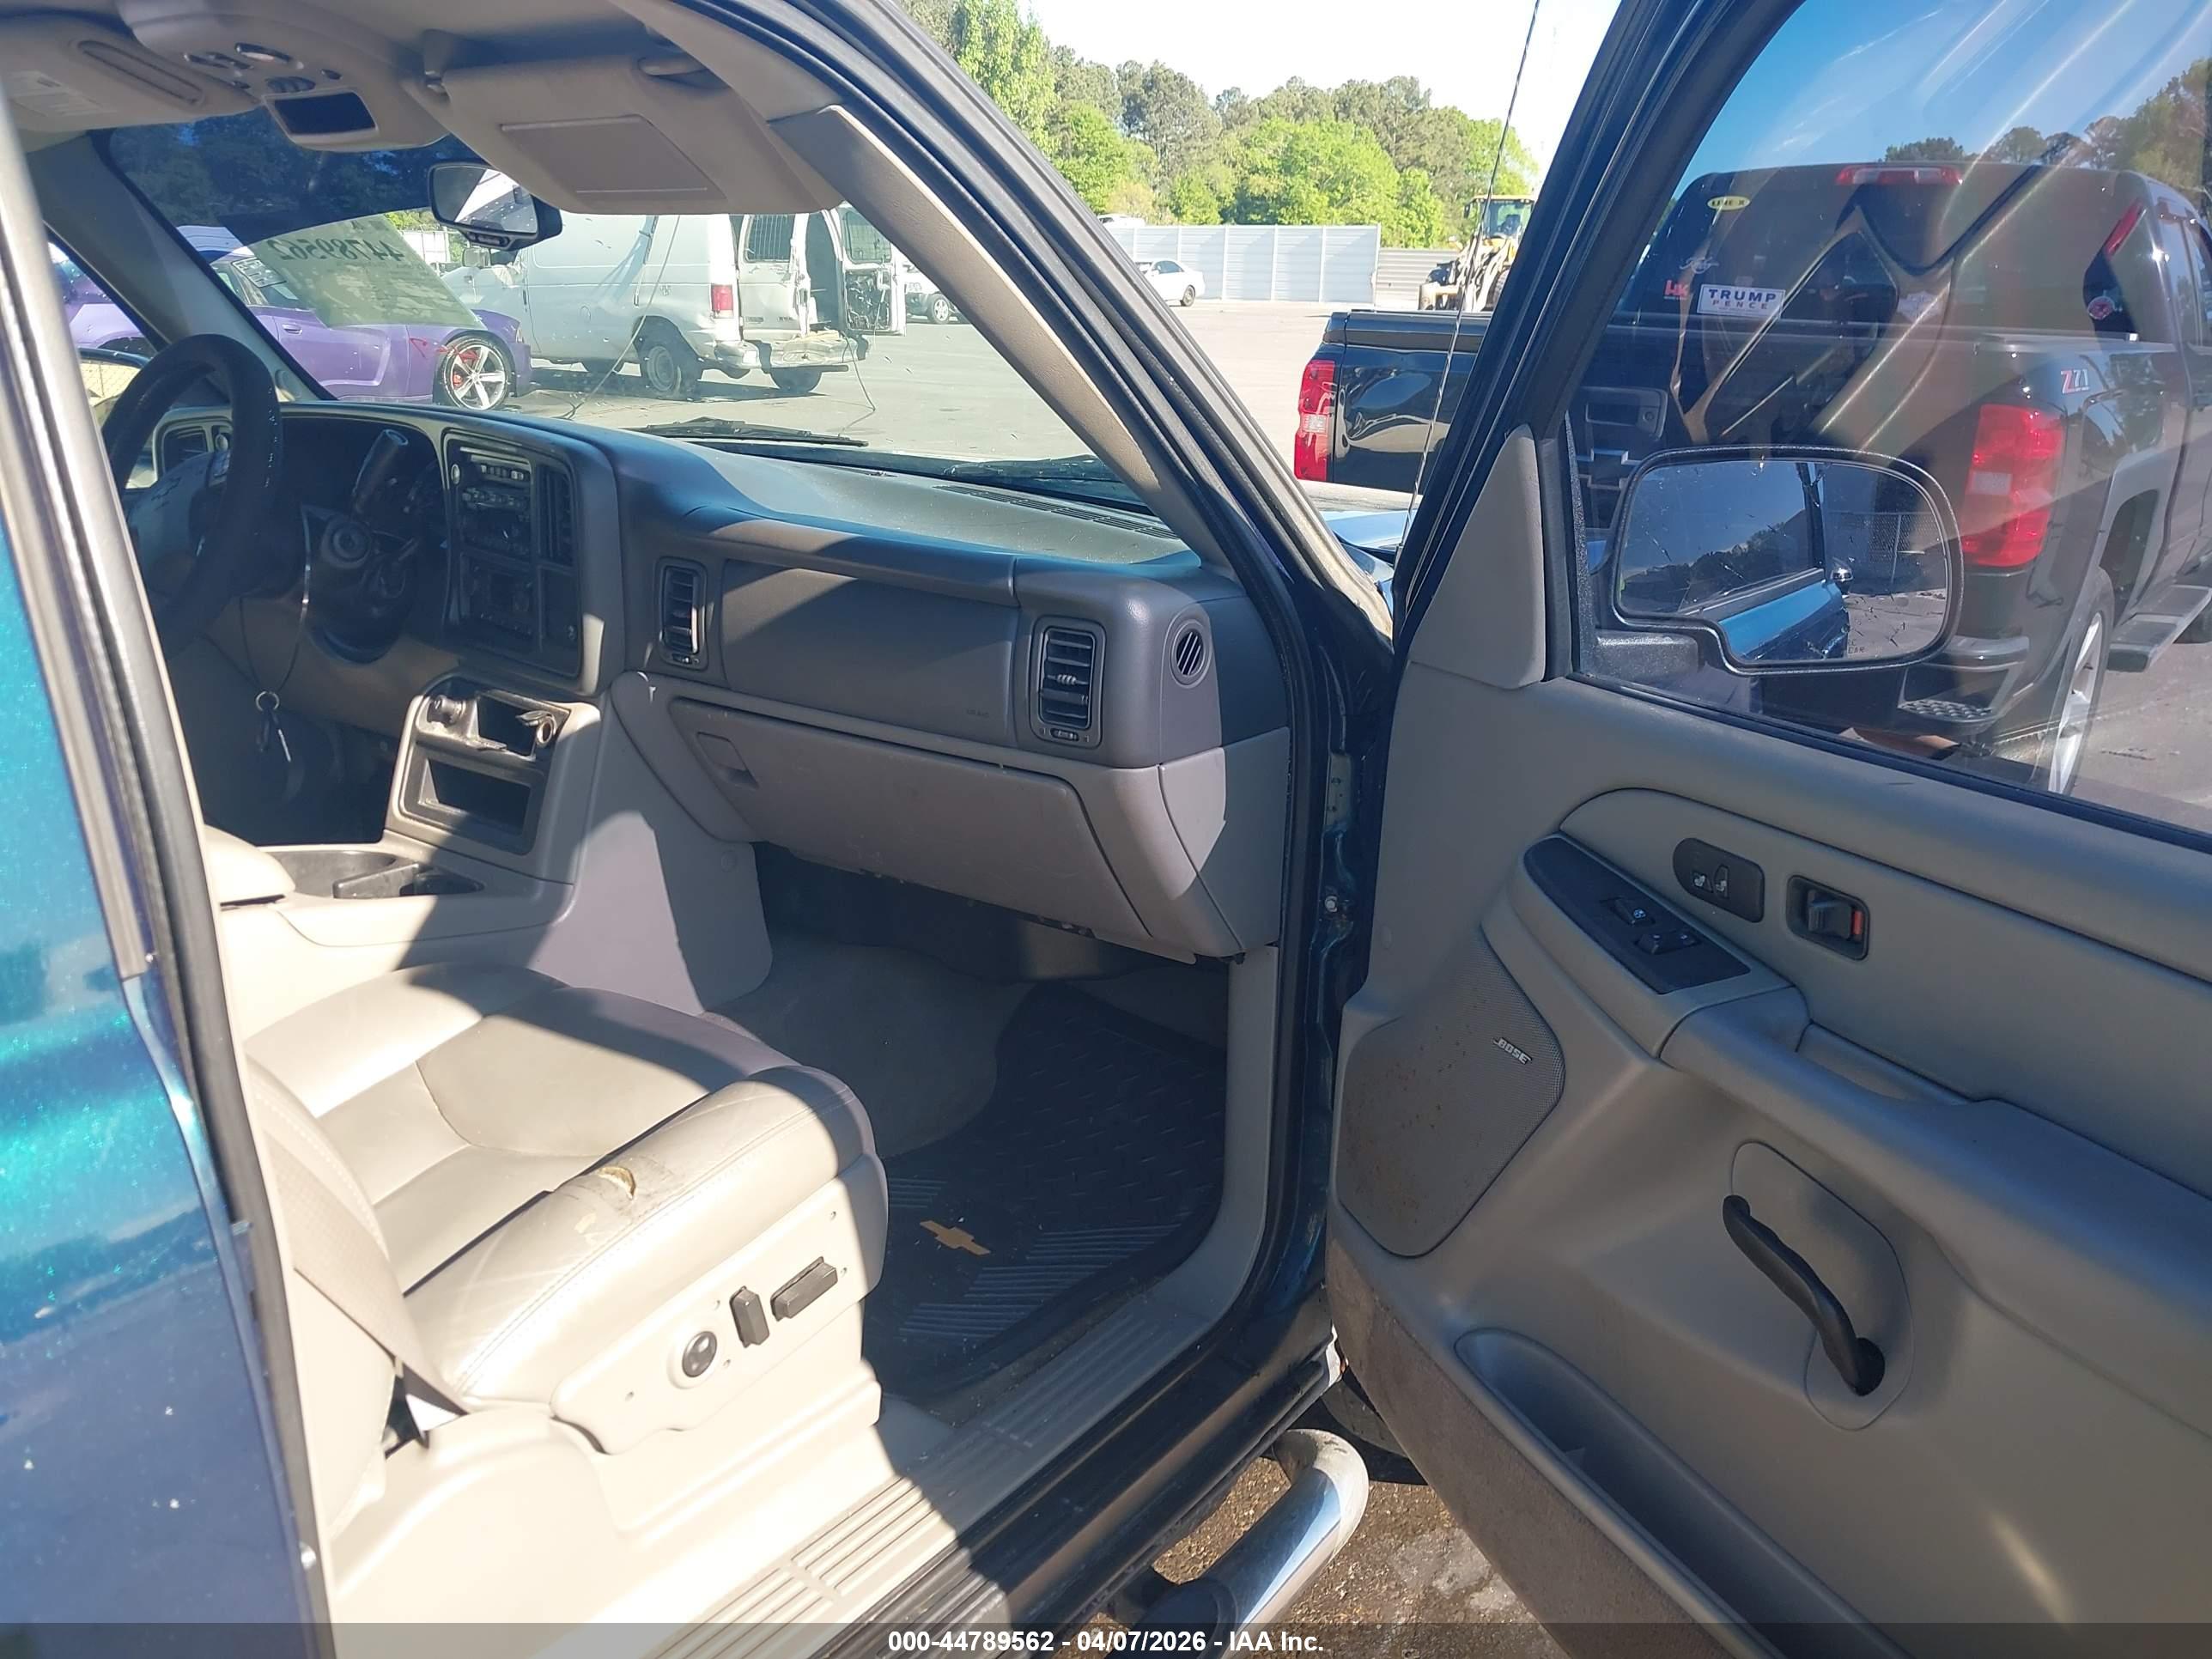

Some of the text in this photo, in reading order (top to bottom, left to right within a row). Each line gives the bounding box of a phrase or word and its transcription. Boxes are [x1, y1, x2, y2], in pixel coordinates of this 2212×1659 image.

[1708, 289, 1777, 302] TRUMP
[1712, 300, 1769, 310] PENCE
[2061, 368, 2089, 394] Z71
[1494, 1036, 1533, 1065] BOSE
